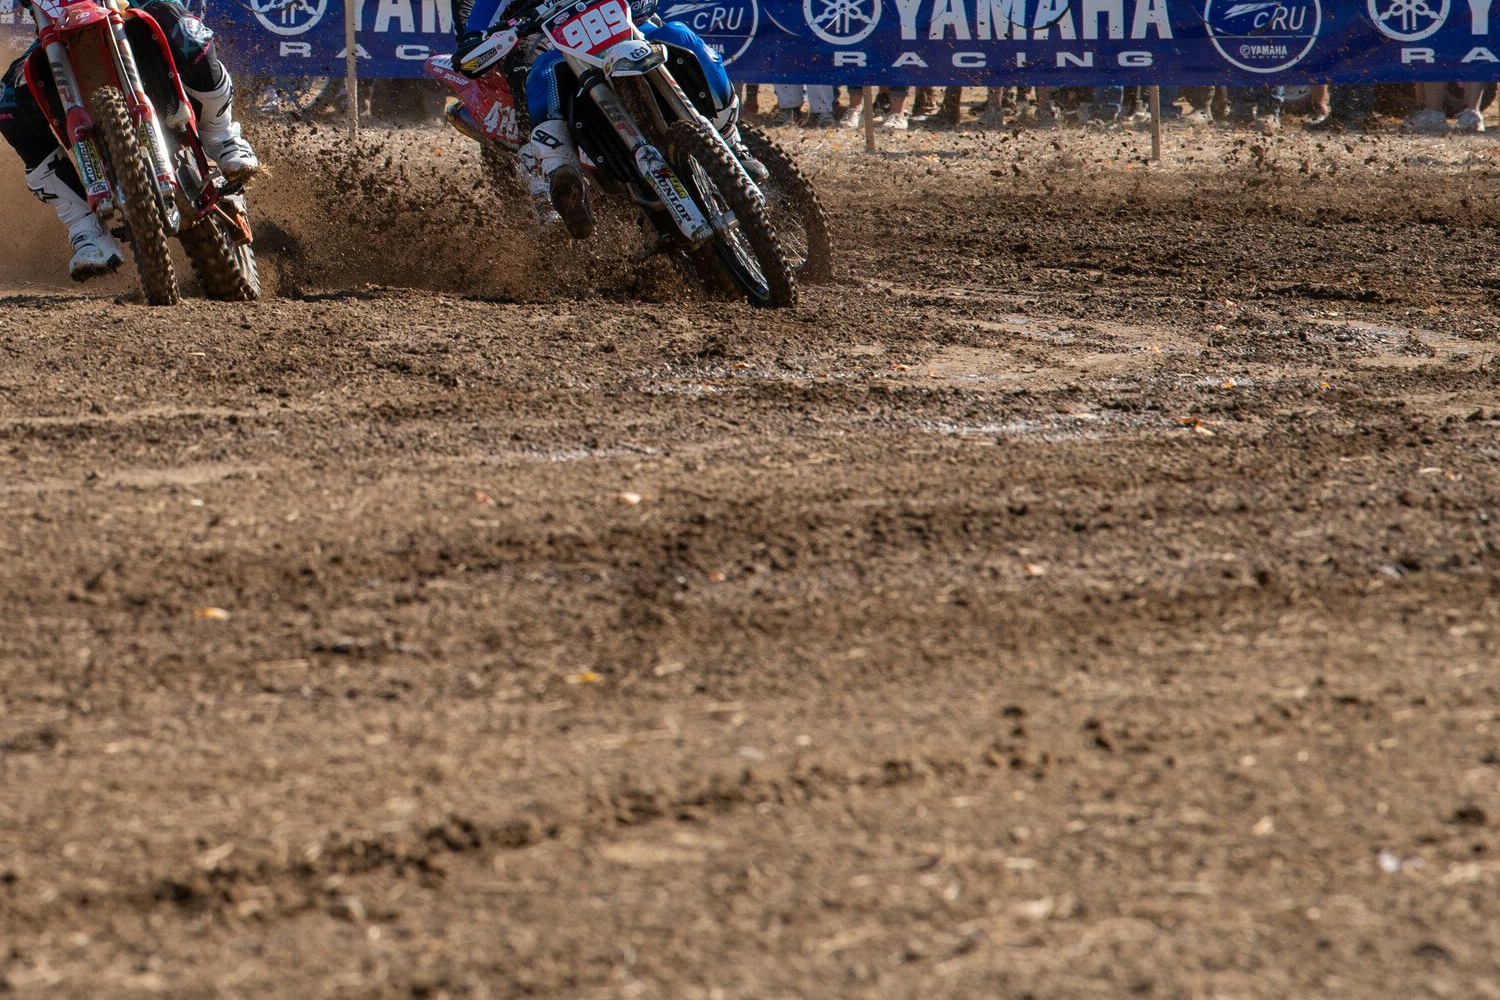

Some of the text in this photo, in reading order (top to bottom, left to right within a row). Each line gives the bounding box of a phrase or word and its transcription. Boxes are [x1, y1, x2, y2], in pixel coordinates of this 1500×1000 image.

[562, 0, 631, 51] 989
[693, 6, 744, 31] cRU
[1253, 6, 1306, 30] cRU
[279, 41, 430, 61] RAC
[833, 49, 1154, 68] RACING
[1250, 45, 1288, 56] YAMAHA
[444, 72, 469, 87] DUNLOP
[78, 140, 95, 181] DUNLOP
[652, 169, 692, 222] DUNLOP
